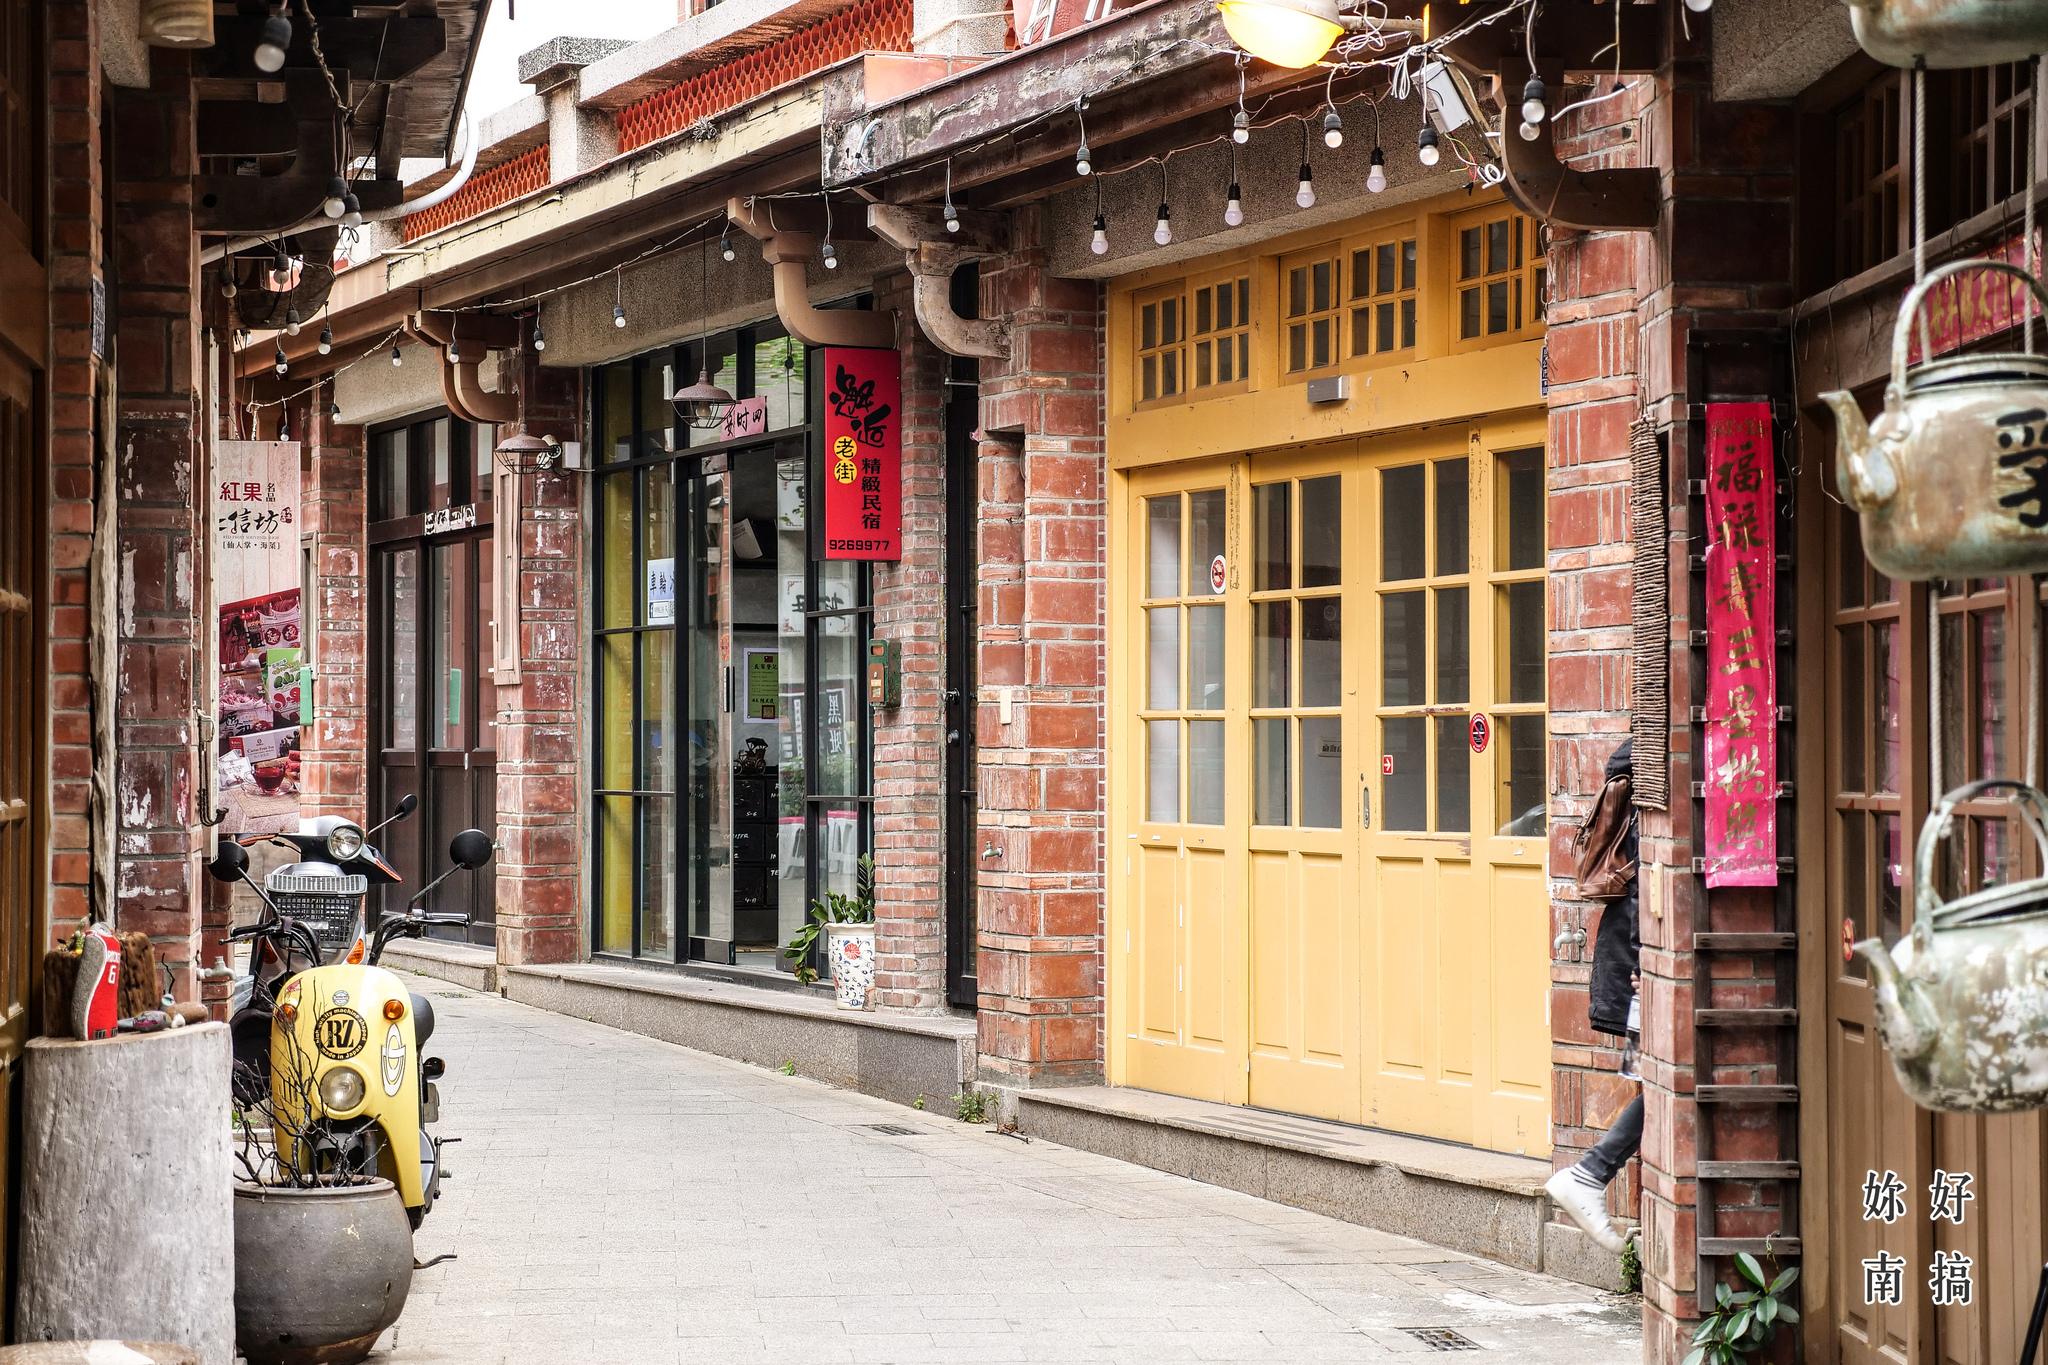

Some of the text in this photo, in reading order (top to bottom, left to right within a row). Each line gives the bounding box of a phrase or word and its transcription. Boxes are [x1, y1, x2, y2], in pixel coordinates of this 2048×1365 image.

[829, 364, 892, 448] 邂逅
[835, 437, 855, 482] 老街
[219, 482, 263, 501] 紅果
[265, 482, 276, 502] 名品
[861, 457, 882, 530] 精緻民宿
[219, 508, 279, 534] 信坊
[829, 540, 890, 551] 9269977
[327, 1020, 354, 1048] RZ
[321, 1047, 336, 1059] made
[345, 1045, 362, 1058] Japan
